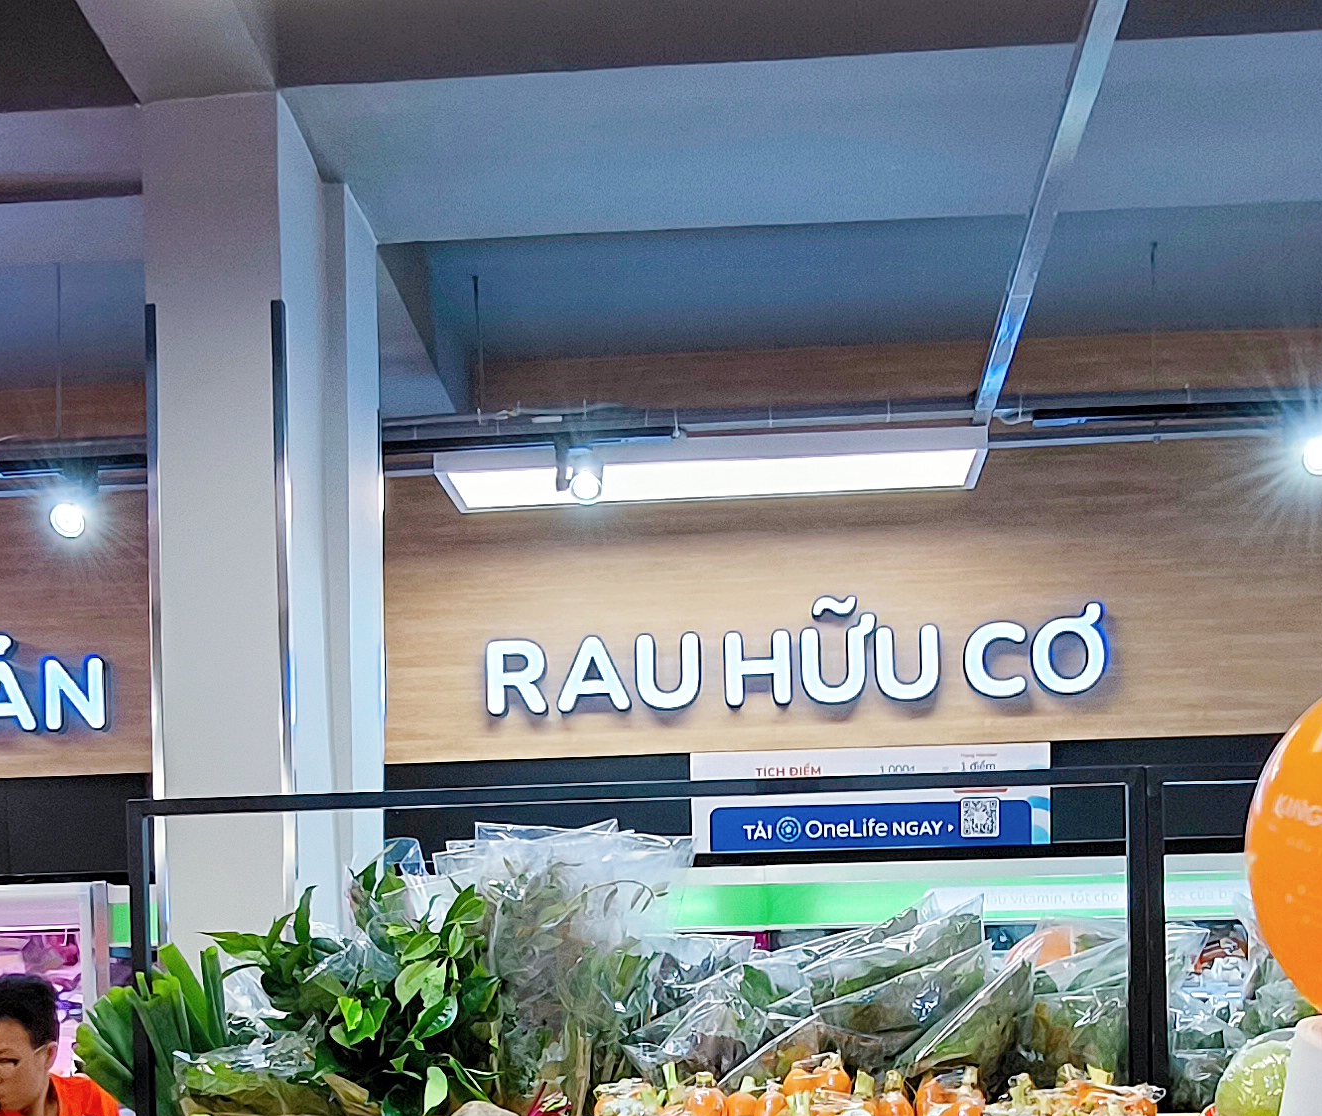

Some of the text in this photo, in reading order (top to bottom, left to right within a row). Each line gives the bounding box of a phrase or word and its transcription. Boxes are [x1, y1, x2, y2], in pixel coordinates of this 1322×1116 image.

[485, 594, 1109, 717] RAU HỮU CƠ
[756, 766, 785, 777] TÍCH
[742, 817, 944, 840] TẢI OneLife NGAY
